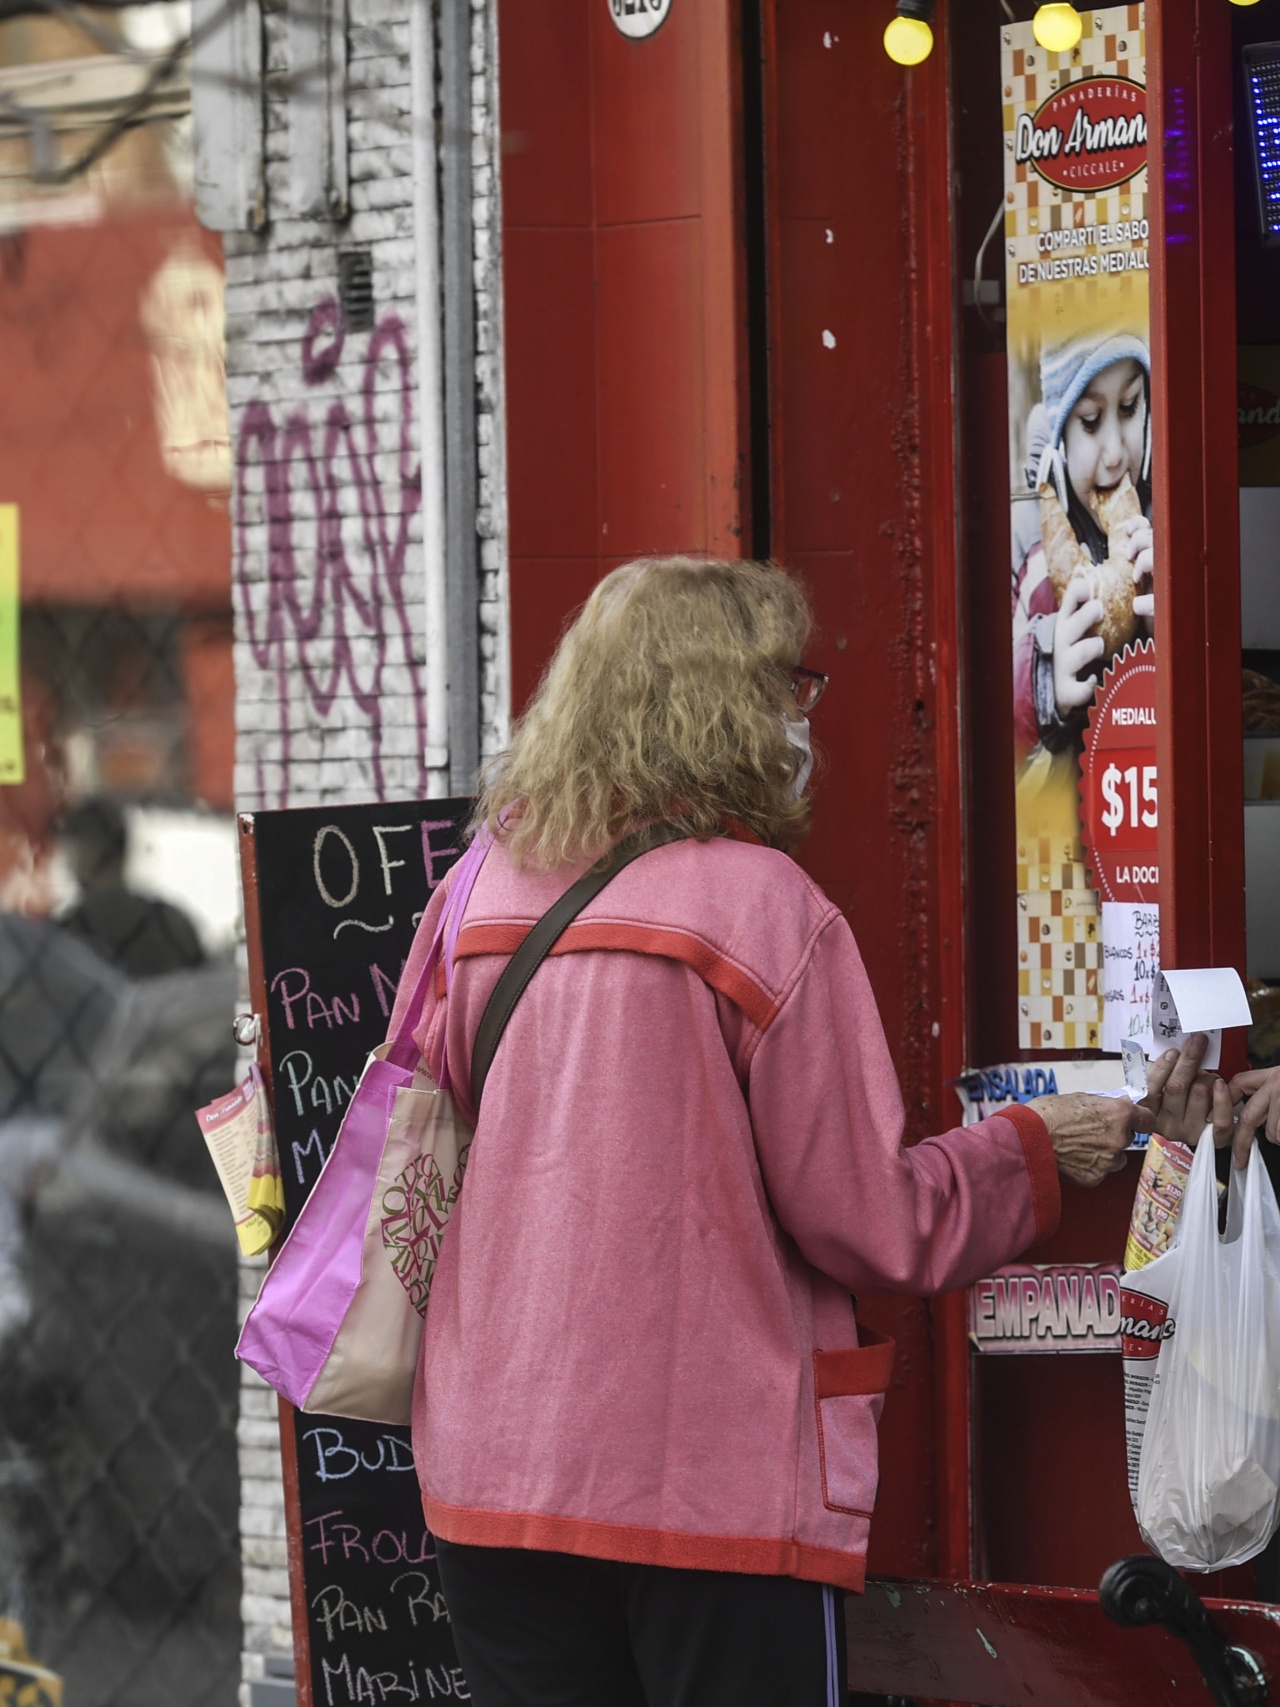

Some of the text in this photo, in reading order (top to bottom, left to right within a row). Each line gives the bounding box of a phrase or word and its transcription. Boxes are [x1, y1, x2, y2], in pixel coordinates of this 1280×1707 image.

[1052, 84, 1137, 112] PANADERÍAS
[1016, 105, 1148, 162] Don Arman
[1069, 159, 1119, 179] CICCALE
[1099, 225, 1114, 244] EL
[1019, 262, 1035, 284] DE
[1036, 256, 1097, 281] NUESTRAS
[1101, 762, 1158, 837] $15
[1116, 865, 1131, 884] LA
[270, 967, 361, 1030] PAN
[976, 1275, 1121, 1340] EMPANAD
[302, 1427, 415, 1482] BUD
[311, 1584, 388, 1642] PAN
